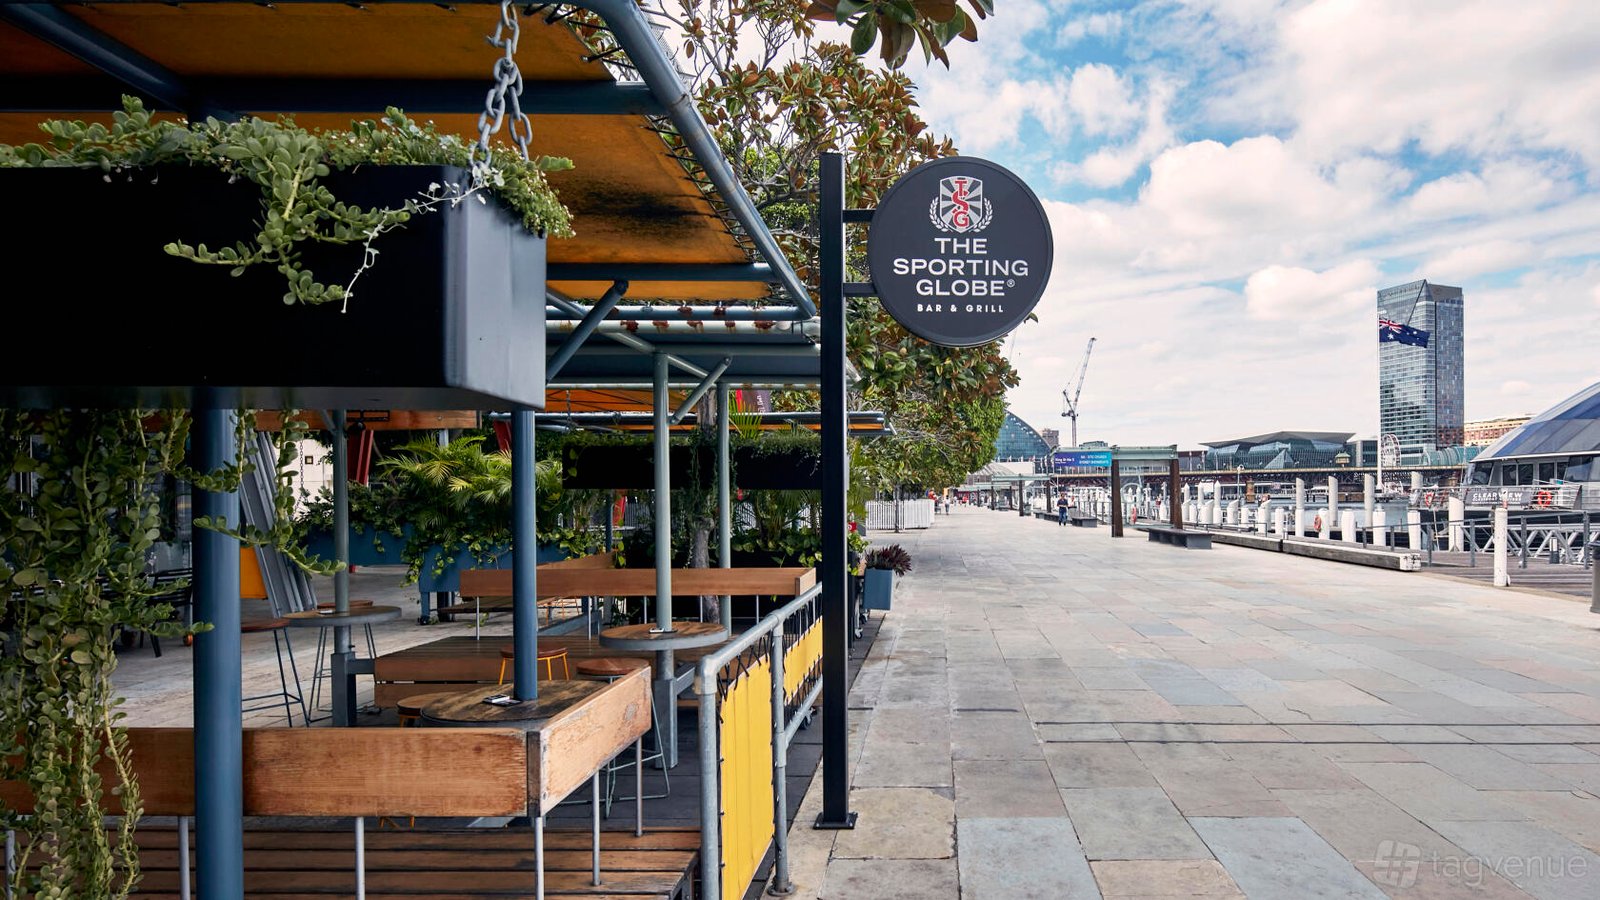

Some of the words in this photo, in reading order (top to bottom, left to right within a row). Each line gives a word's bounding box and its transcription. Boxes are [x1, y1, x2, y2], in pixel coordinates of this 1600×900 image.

[934, 238, 988, 254] THE
[893, 258, 1029, 276] SPORTING
[917, 304, 942, 312] BAR
[950, 304, 957, 312] &
[965, 304, 1004, 313] GRILL
